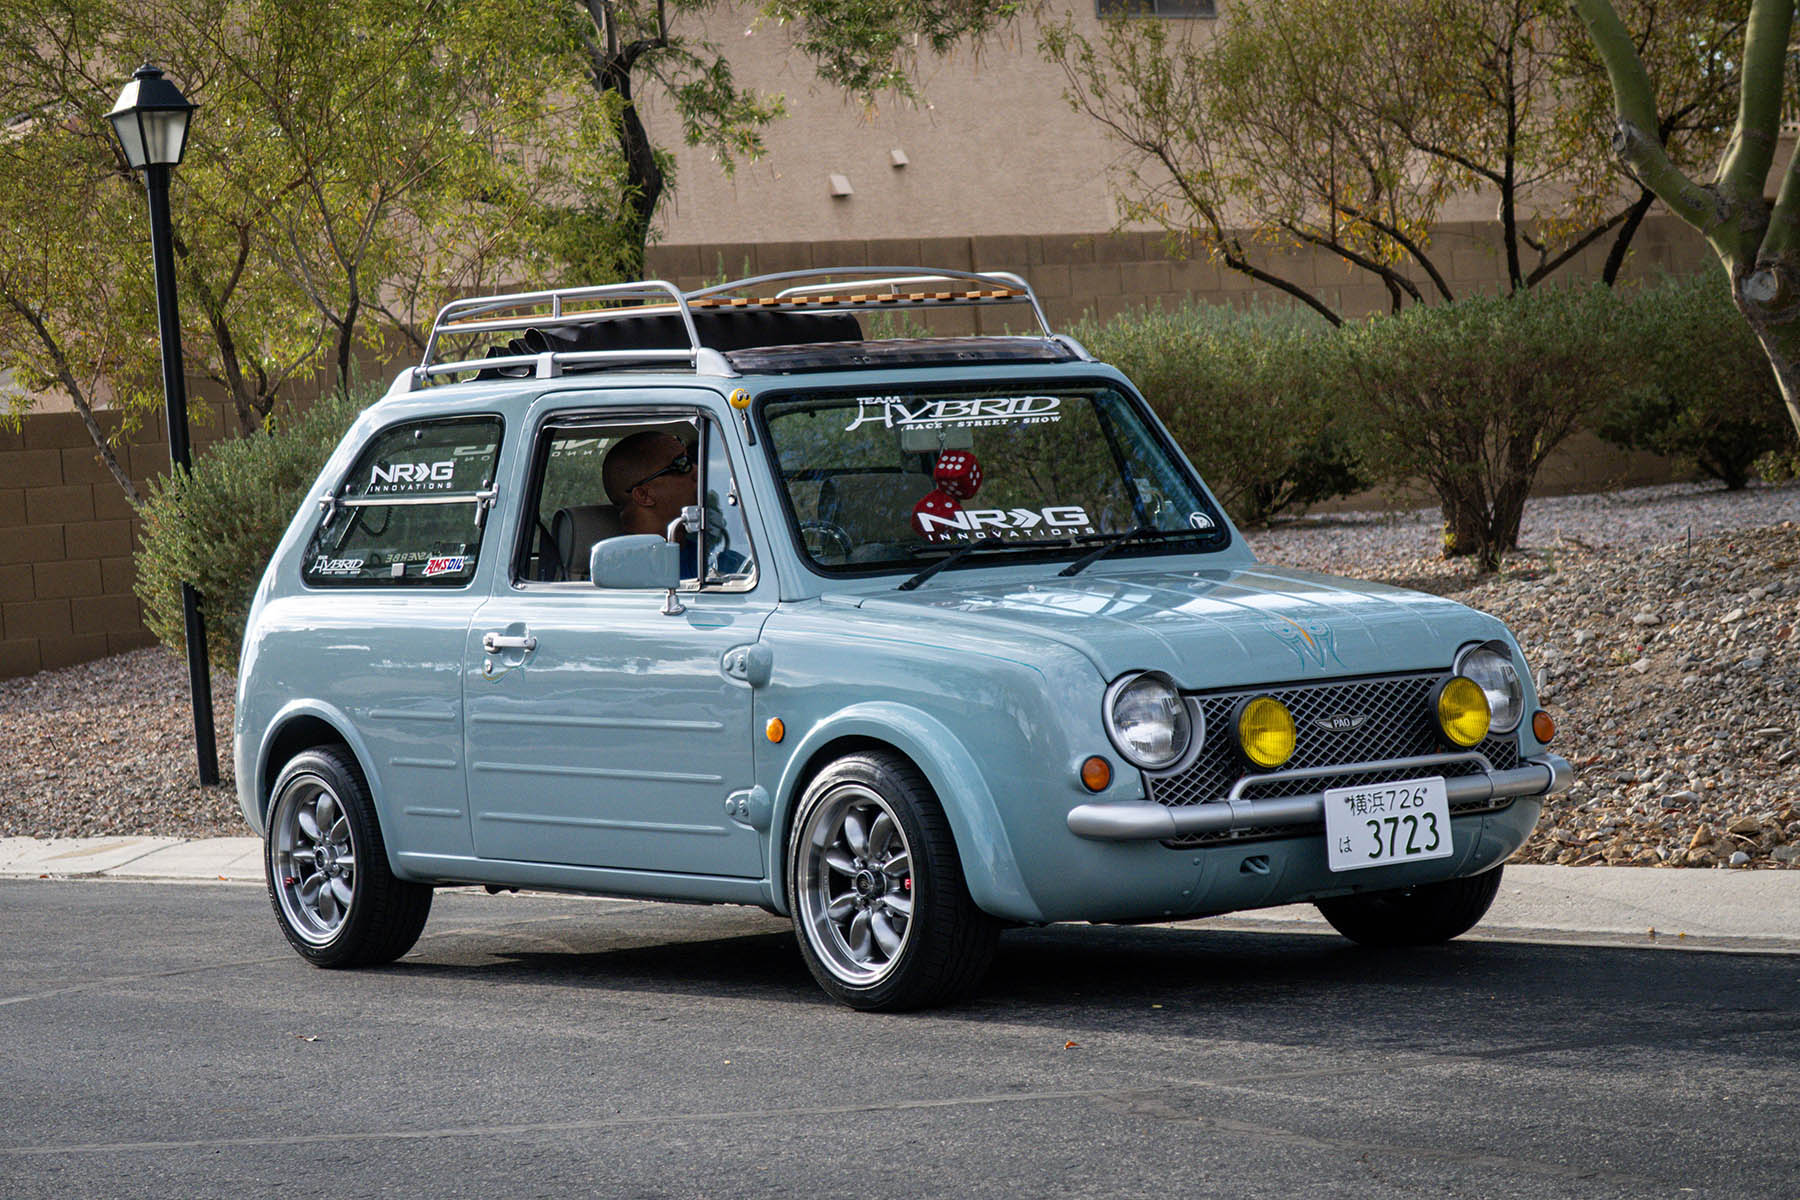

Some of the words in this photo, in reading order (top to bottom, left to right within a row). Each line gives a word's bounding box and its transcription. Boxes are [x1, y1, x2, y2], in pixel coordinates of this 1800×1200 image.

[856, 396, 902, 405] TEAM
[845, 396, 1061, 432] HYBRID
[902, 422, 943, 432] RACE
[957, 419, 1009, 428] STREET
[1023, 416, 1062, 424] SHOW
[370, 482, 453, 492] INNOVATIONS
[928, 527, 1096, 542] INNOVATIONS
[424, 558, 463, 575] AMSOIL
[1333, 717, 1351, 728] PAO
[1339, 836, 1352, 853] は
[1366, 812, 1440, 859] 3723
